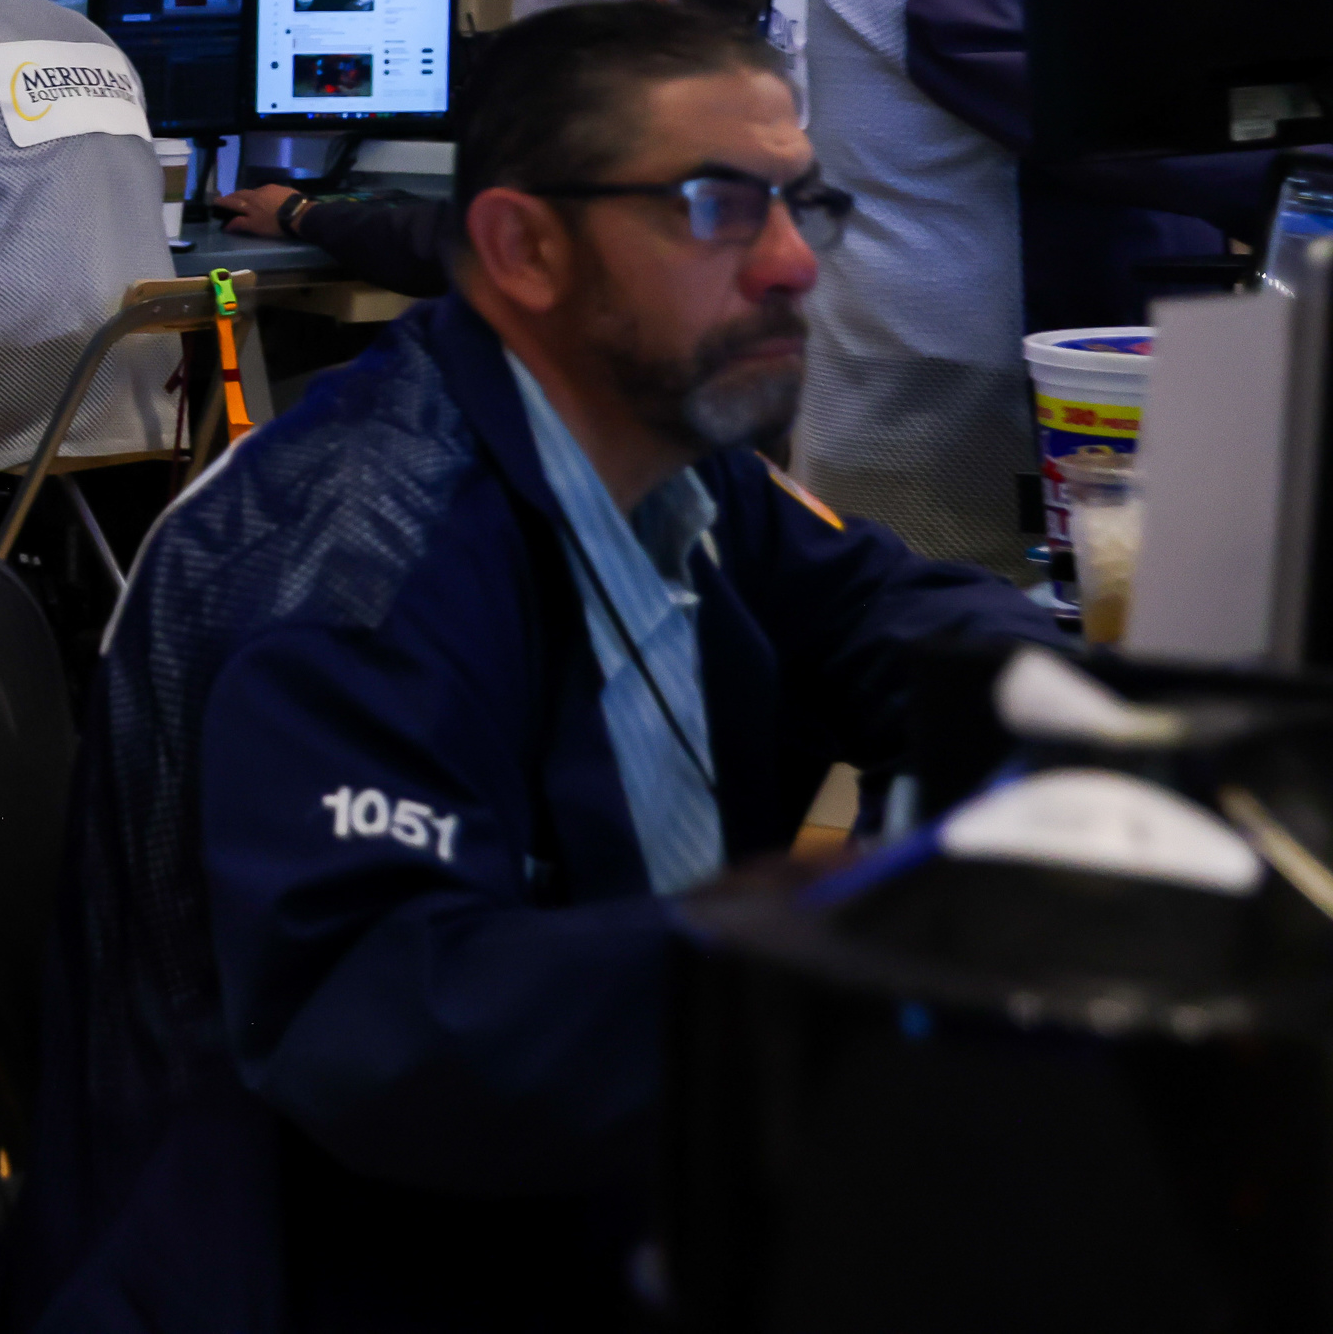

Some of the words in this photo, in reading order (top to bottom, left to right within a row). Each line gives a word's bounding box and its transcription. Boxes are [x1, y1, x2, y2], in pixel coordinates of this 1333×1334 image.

[22, 66, 133, 93] MERIDIAN
[29, 85, 83, 104] EQUITY
[321, 783, 459, 862] 1051
